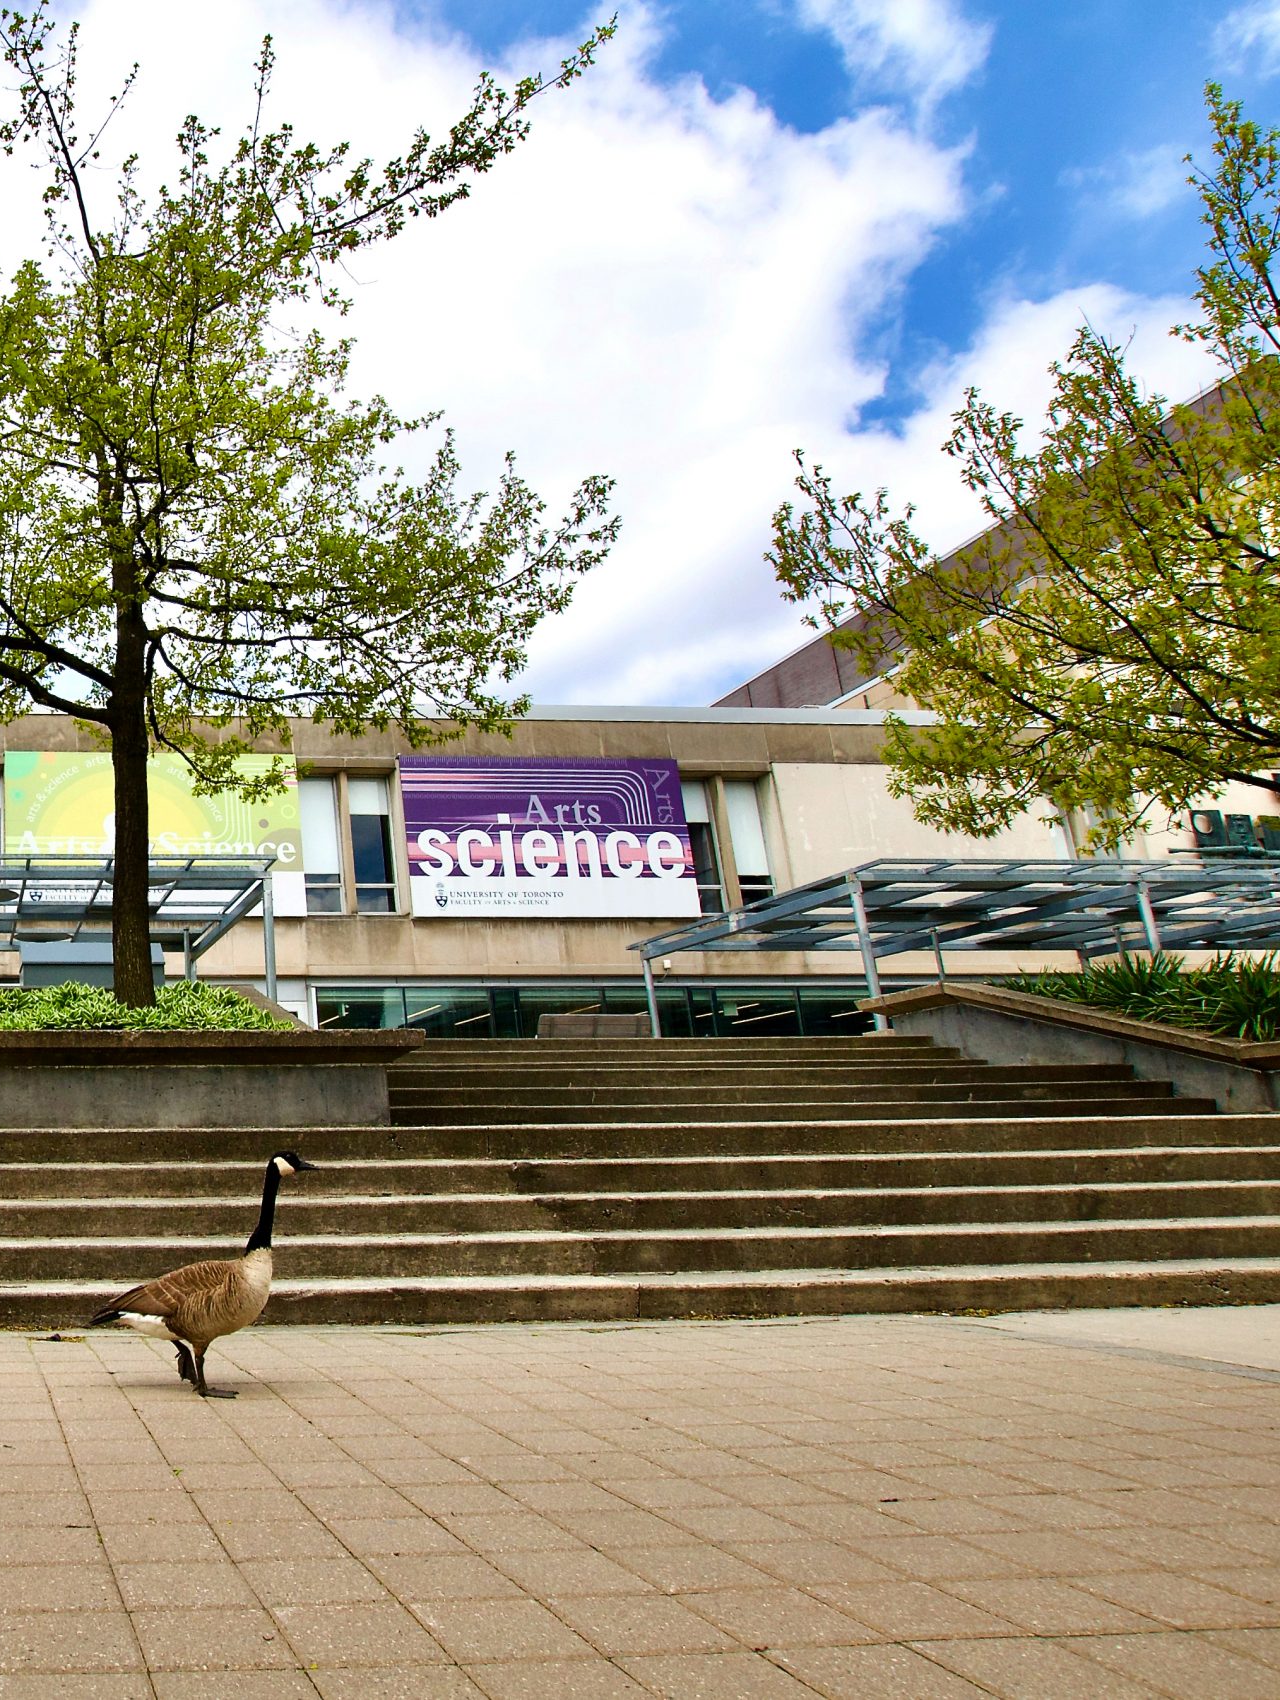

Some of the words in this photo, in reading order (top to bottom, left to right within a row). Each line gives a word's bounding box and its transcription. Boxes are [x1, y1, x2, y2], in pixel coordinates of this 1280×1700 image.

[44, 765, 81, 795] science
[524, 794, 602, 825] Arts
[643, 767, 675, 824] Arts
[17, 830, 99, 855] Arts
[417, 812, 687, 878] science
[449, 890, 504, 899] UNIVERSITY
[507, 890, 519, 899] OF
[523, 890, 564, 899] TORONTO
